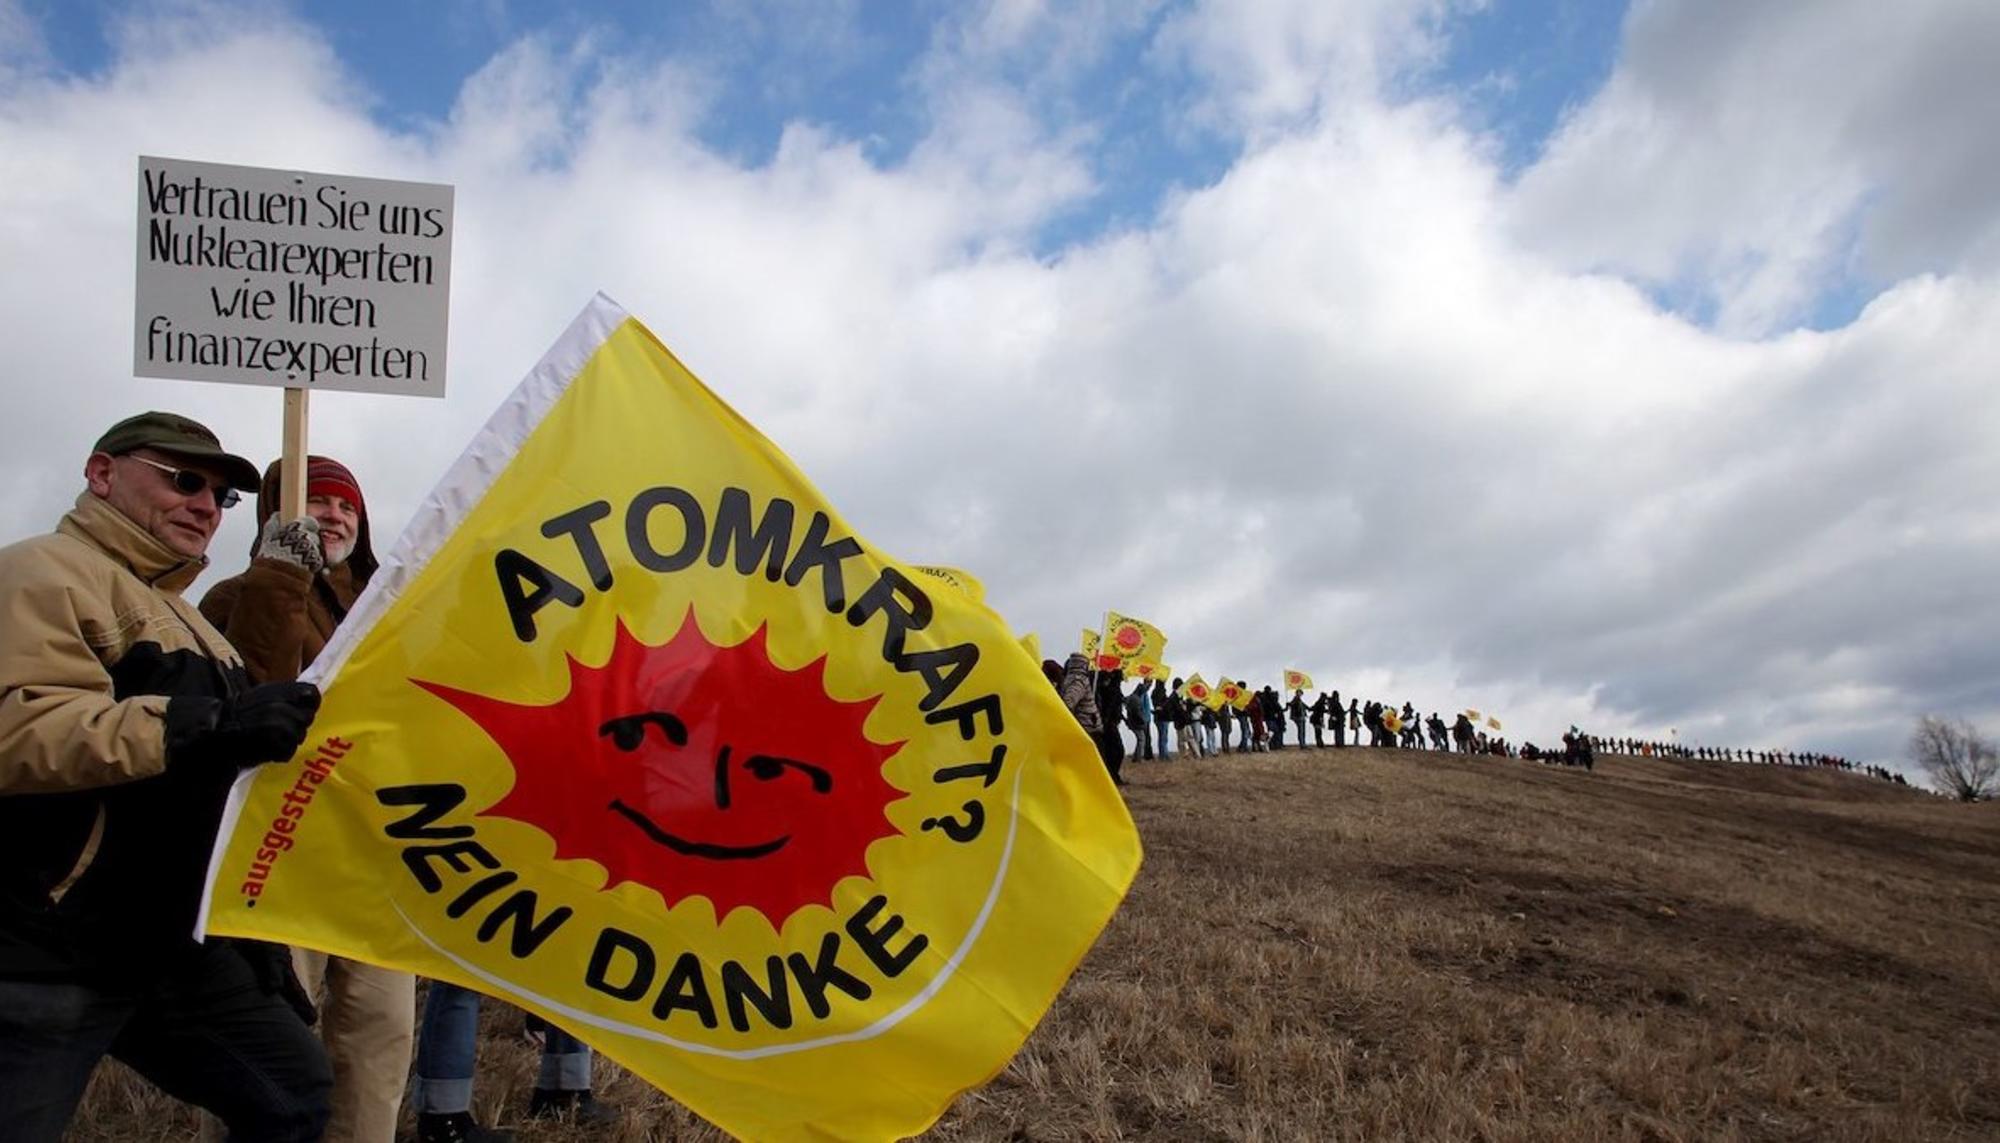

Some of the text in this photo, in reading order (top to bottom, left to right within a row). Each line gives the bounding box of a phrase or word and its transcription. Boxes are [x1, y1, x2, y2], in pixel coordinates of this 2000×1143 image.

[144, 169, 444, 238] Vertrauen Sie uns
[150, 218, 433, 285] Nuklearexperten
[211, 278, 376, 328] wie Ihren
[494, 487, 1008, 844] ATOMKRAFT?
[375, 784, 928, 1032] NEIN DANKE
